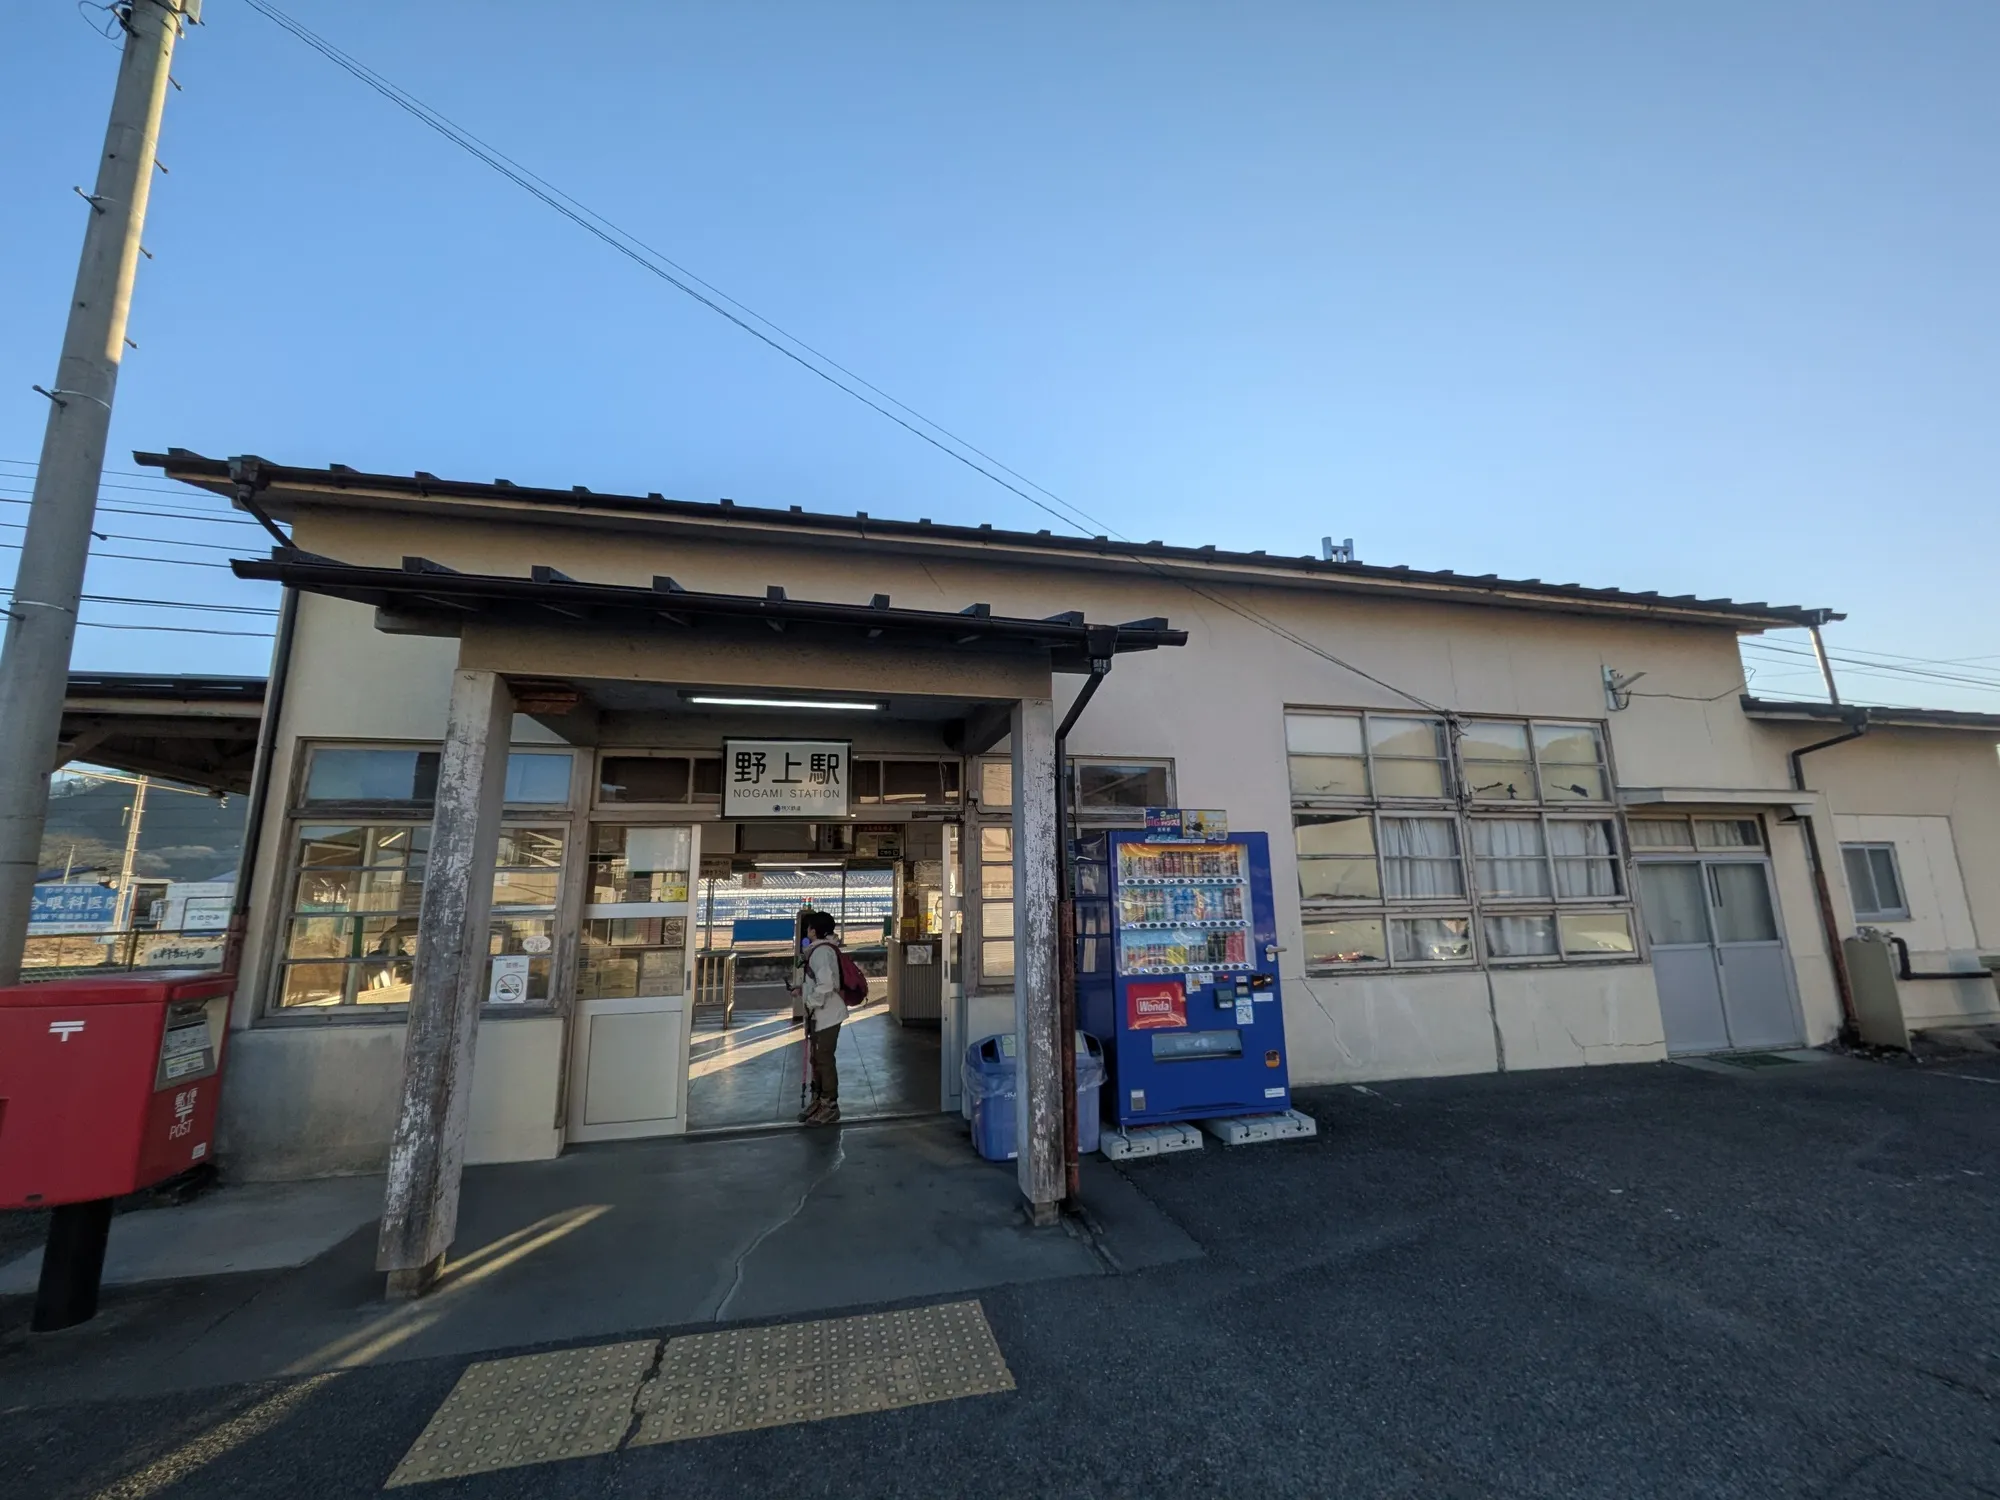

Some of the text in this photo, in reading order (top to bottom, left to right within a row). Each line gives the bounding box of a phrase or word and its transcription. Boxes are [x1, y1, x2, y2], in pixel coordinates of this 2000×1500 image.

[733, 752, 840, 785] 野上駅
[733, 788, 840, 799] NOGAMI STATION
[1139, 1000, 1169, 1013] Wonda
[175, 1088, 198, 1109] 郵便
[168, 1119, 193, 1141] POST
